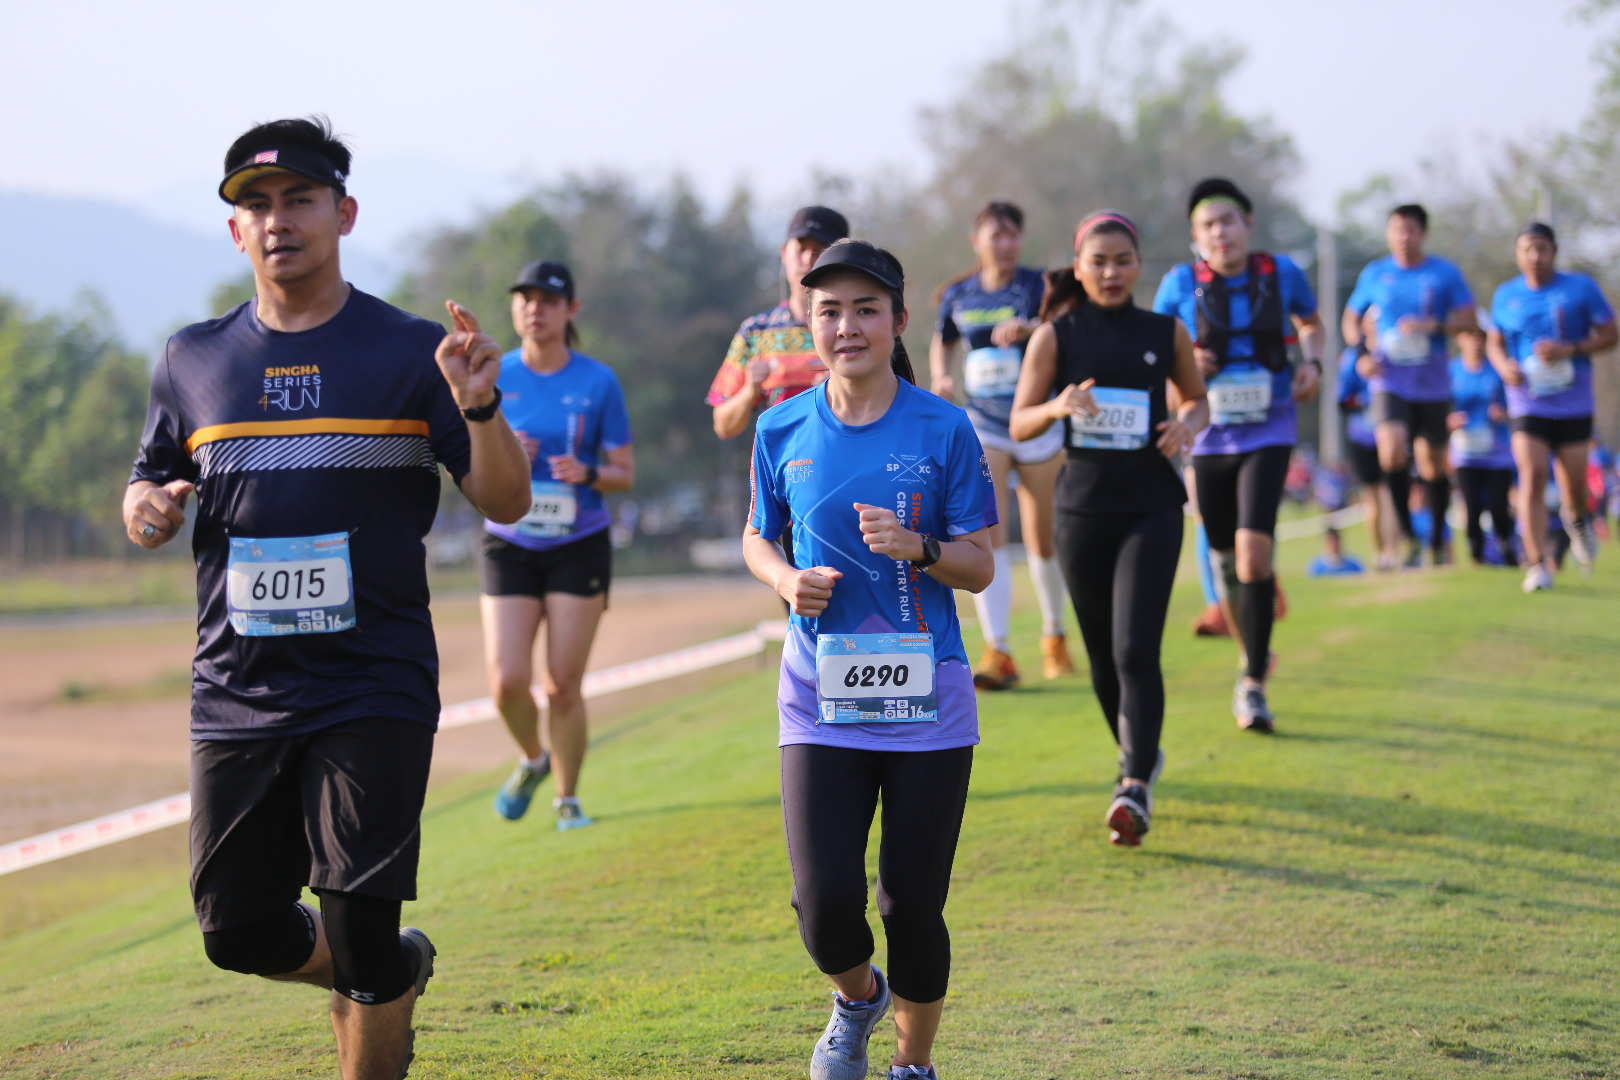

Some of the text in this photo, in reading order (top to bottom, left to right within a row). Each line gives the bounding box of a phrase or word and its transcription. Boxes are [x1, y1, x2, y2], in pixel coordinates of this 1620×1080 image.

[264, 364, 321, 378] SINGHA
[263, 375, 322, 389] SERIES
[786, 458, 814, 468] SINGHA
[886, 463, 931, 474] SP XC
[252, 567, 326, 601] 6015
[899, 595, 911, 622] RUN
[912, 587, 928, 633] CHIAN
[843, 664, 909, 688] 6290
[825, 704, 832, 717] F
